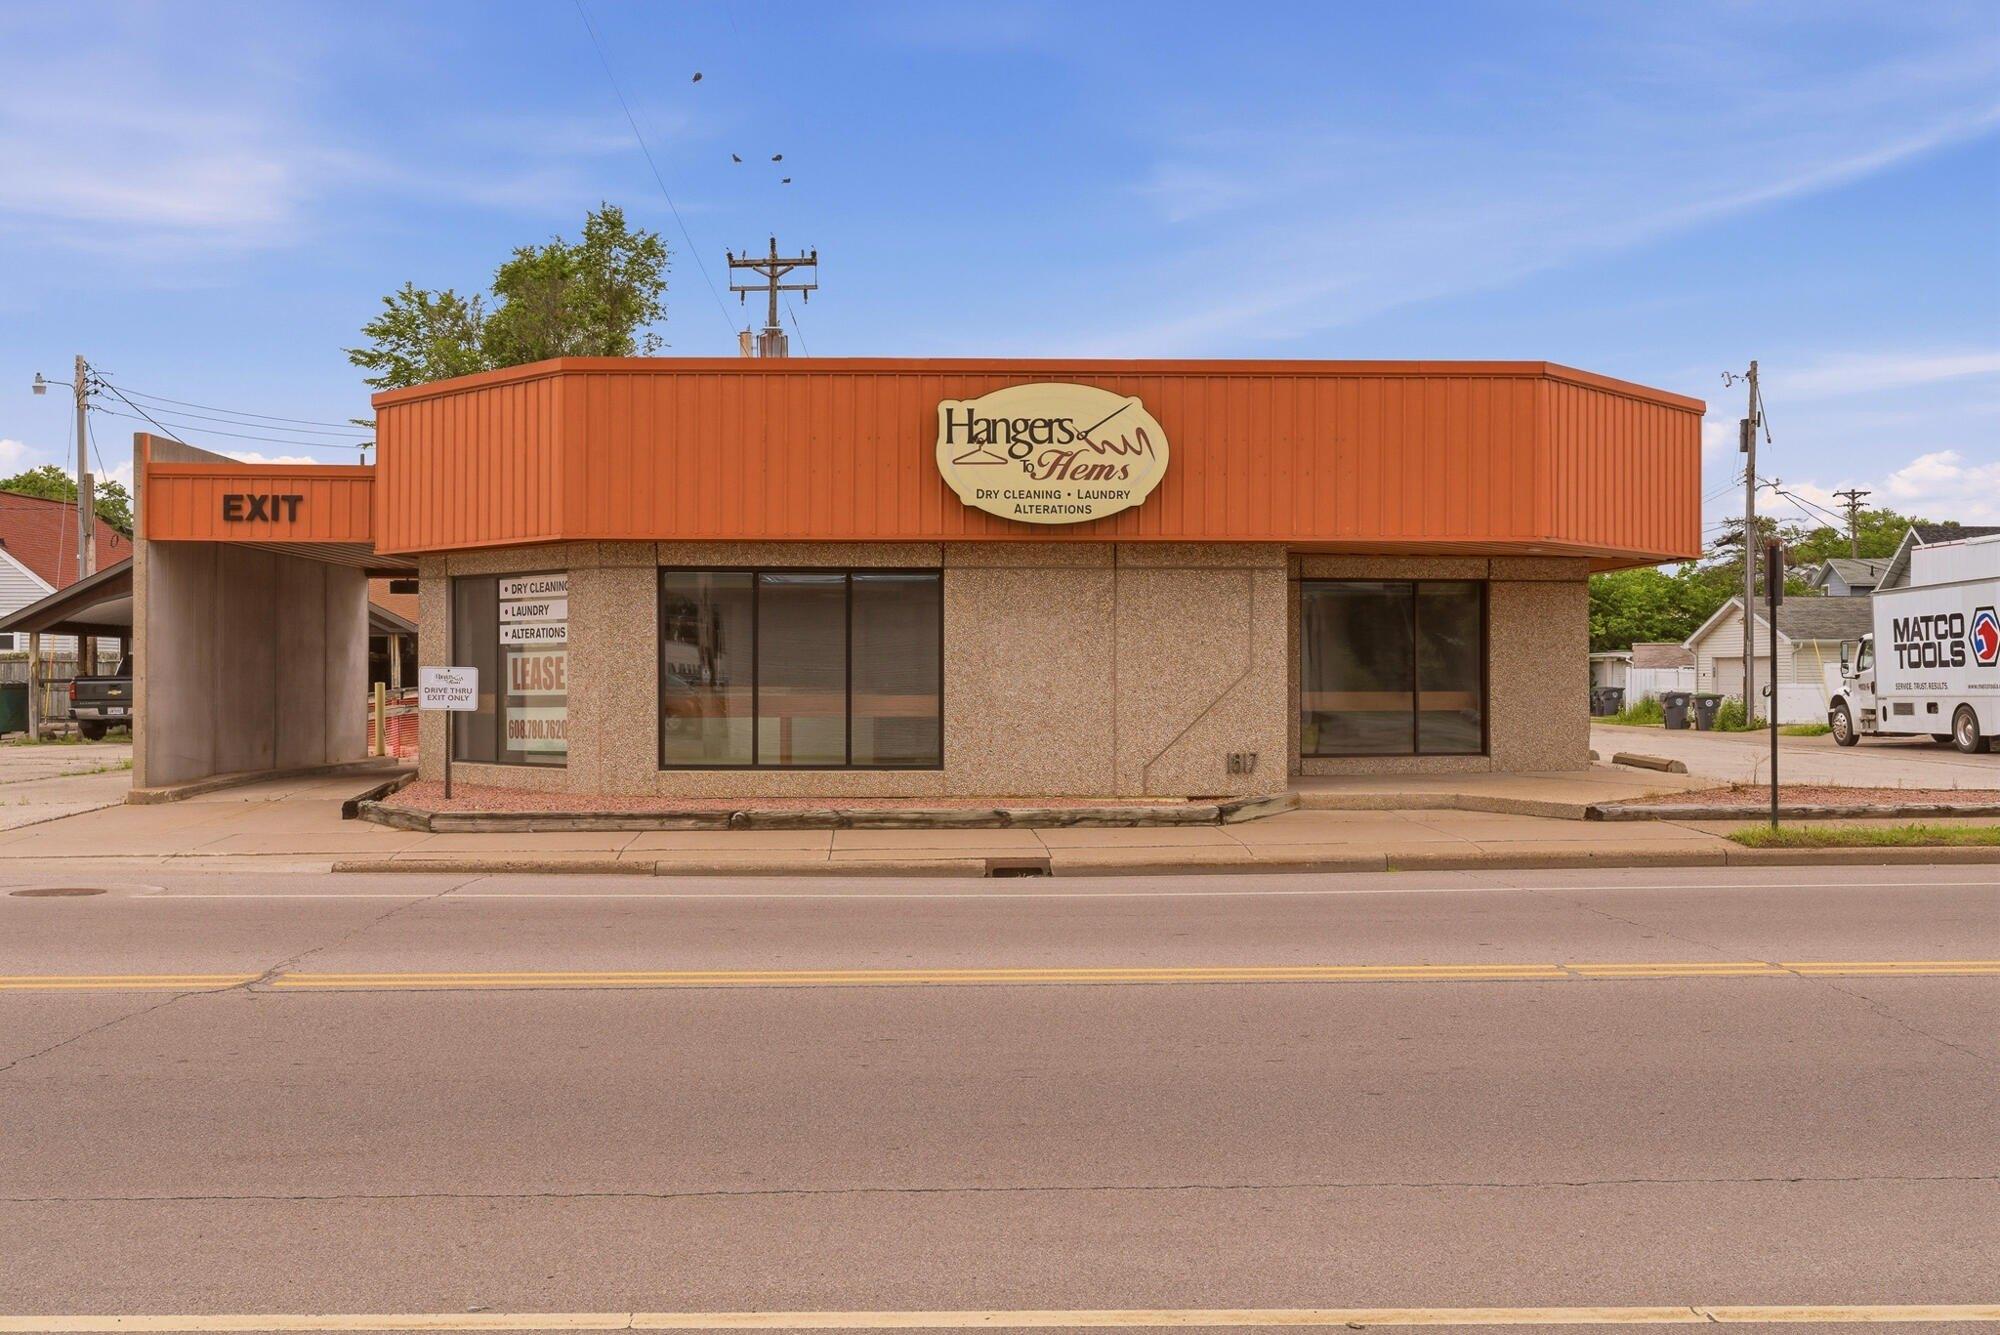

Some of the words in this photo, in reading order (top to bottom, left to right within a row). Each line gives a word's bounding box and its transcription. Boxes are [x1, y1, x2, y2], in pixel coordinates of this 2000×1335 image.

[945, 408, 1075, 459] Hangers
[1020, 459, 1035, 473] To
[1030, 449, 1130, 481] Hems
[976, 488, 999, 500] DRY
[1004, 489, 1062, 500] CLEANING
[1077, 488, 1131, 500] LAUNDRY
[223, 494, 304, 522] EXIT
[1014, 503, 1092, 515] ALTERATIONS
[511, 583, 528, 594] DRY
[511, 604, 549, 617] LAUNDRY
[511, 627, 566, 640] ALTERATIONS
[1892, 612, 1965, 643] MATCO
[1894, 640, 1966, 669] TOOLS
[512, 656, 566, 690] LEASE
[450, 687, 473, 695] THRU
[447, 694, 469, 702] ONLY
